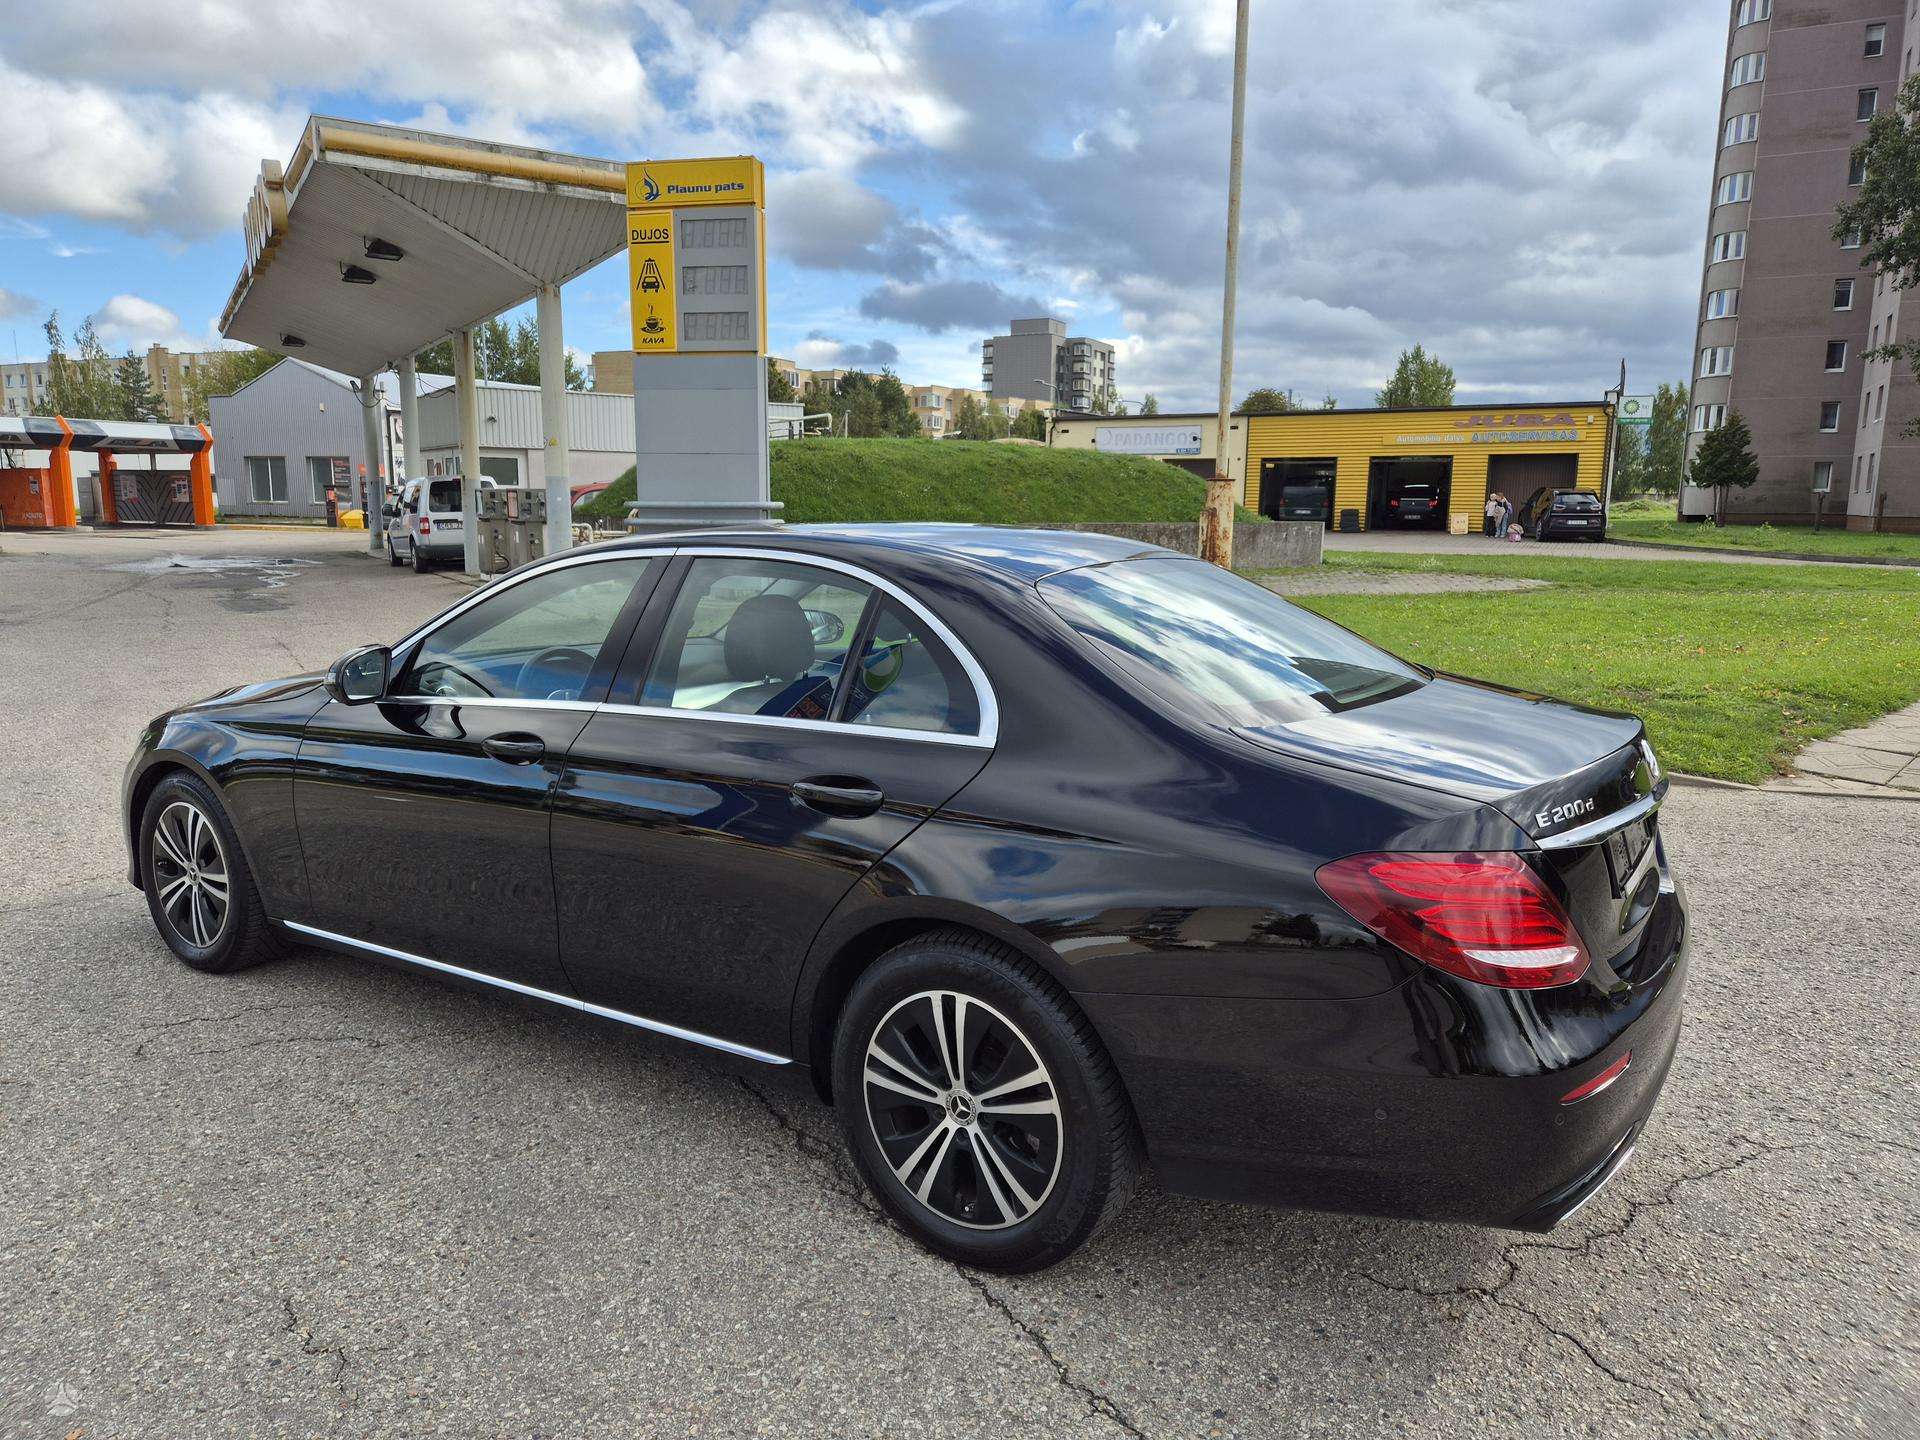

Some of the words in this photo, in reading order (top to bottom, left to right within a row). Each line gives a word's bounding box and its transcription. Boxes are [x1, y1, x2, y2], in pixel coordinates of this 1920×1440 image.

[667, 184, 712, 194] Plaunu
[714, 182, 744, 193] pats
[631, 228, 669, 241] DUJOS
[1535, 812, 1551, 828] E
